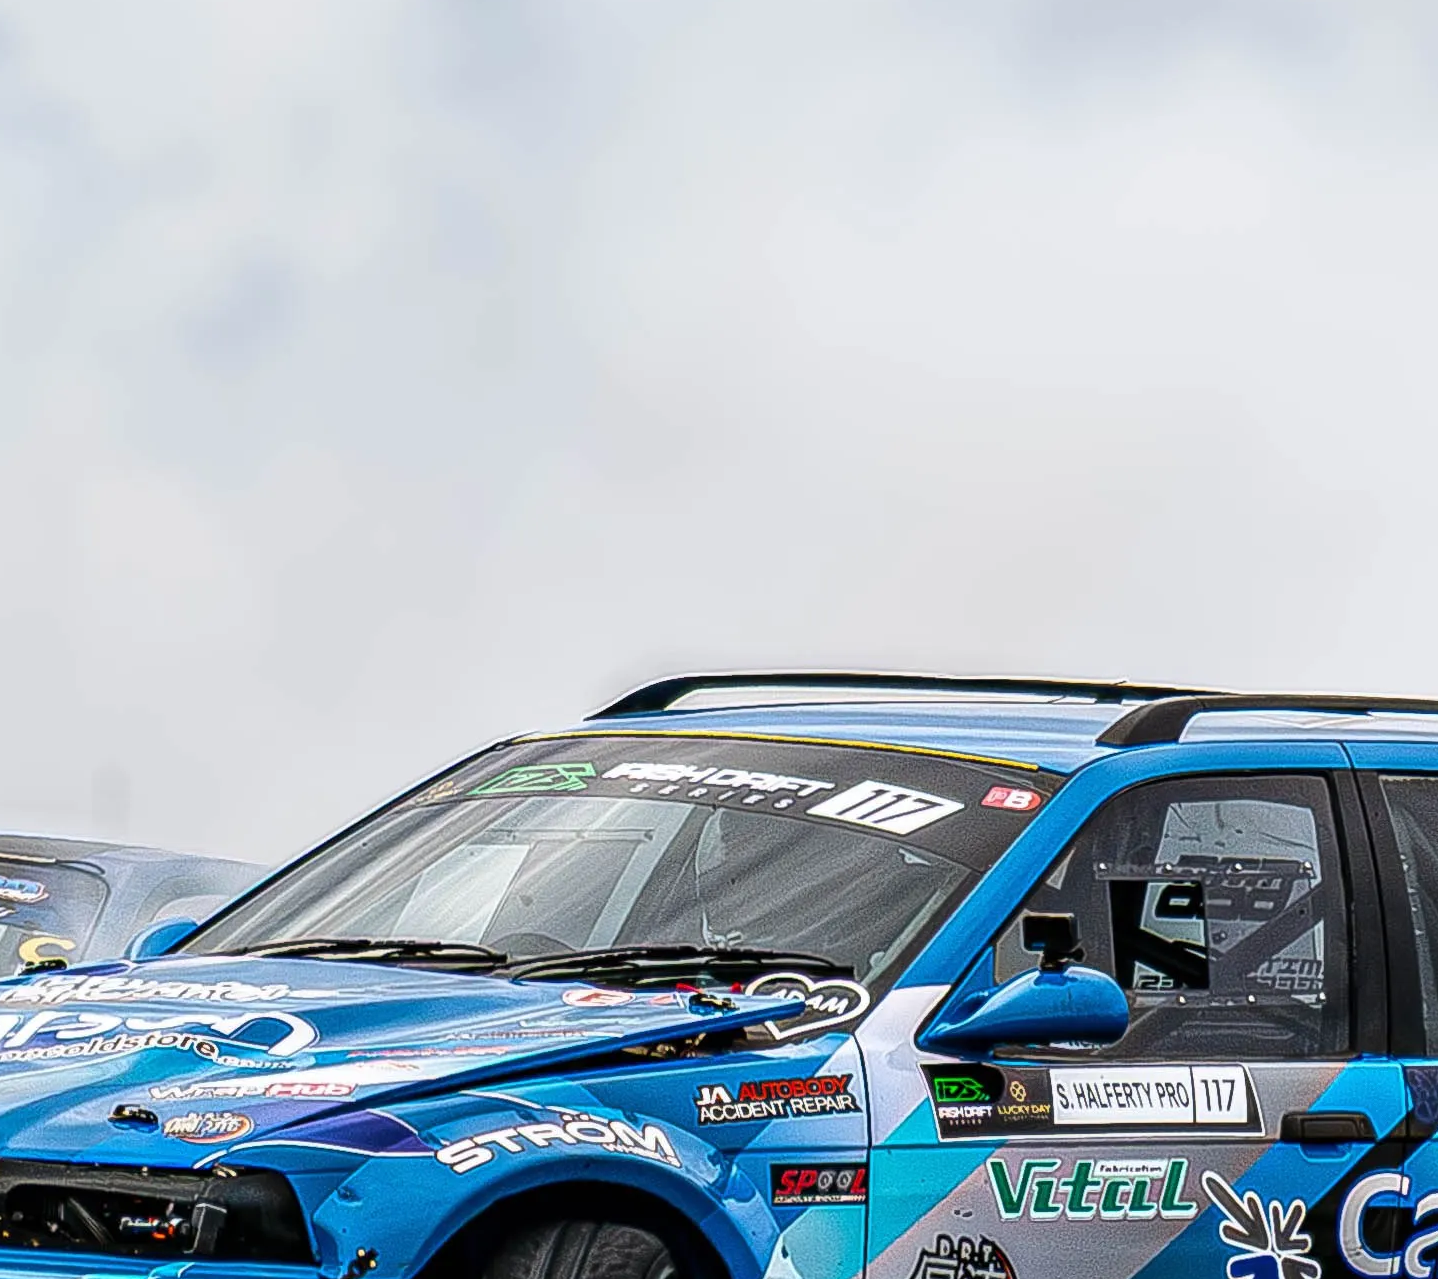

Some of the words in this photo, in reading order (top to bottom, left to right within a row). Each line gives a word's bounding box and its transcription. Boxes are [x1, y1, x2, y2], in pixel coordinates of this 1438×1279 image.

[629, 783, 795, 810] SERIES
[711, 768, 836, 798] DRIFT
[836, 789, 934, 824] 117
[696, 1086, 732, 1106] JA
[739, 1076, 847, 1102] AUTOBODY
[1056, 1083, 1075, 1110] S.
[1078, 1082, 1153, 1110] HALFERTY
[1157, 1081, 1190, 1110] PRO
[1199, 1078, 1236, 1112] 117
[700, 1099, 785, 1122] ACCIDENT
[790, 1094, 855, 1114] REPAIR
[997, 1104, 1030, 1115] LUCKY
[1031, 1104, 1051, 1114] DAY
[436, 1113, 678, 1174] STRÖM
[775, 1168, 867, 1195] SPOOL
[986, 1158, 1198, 1221] Vital
